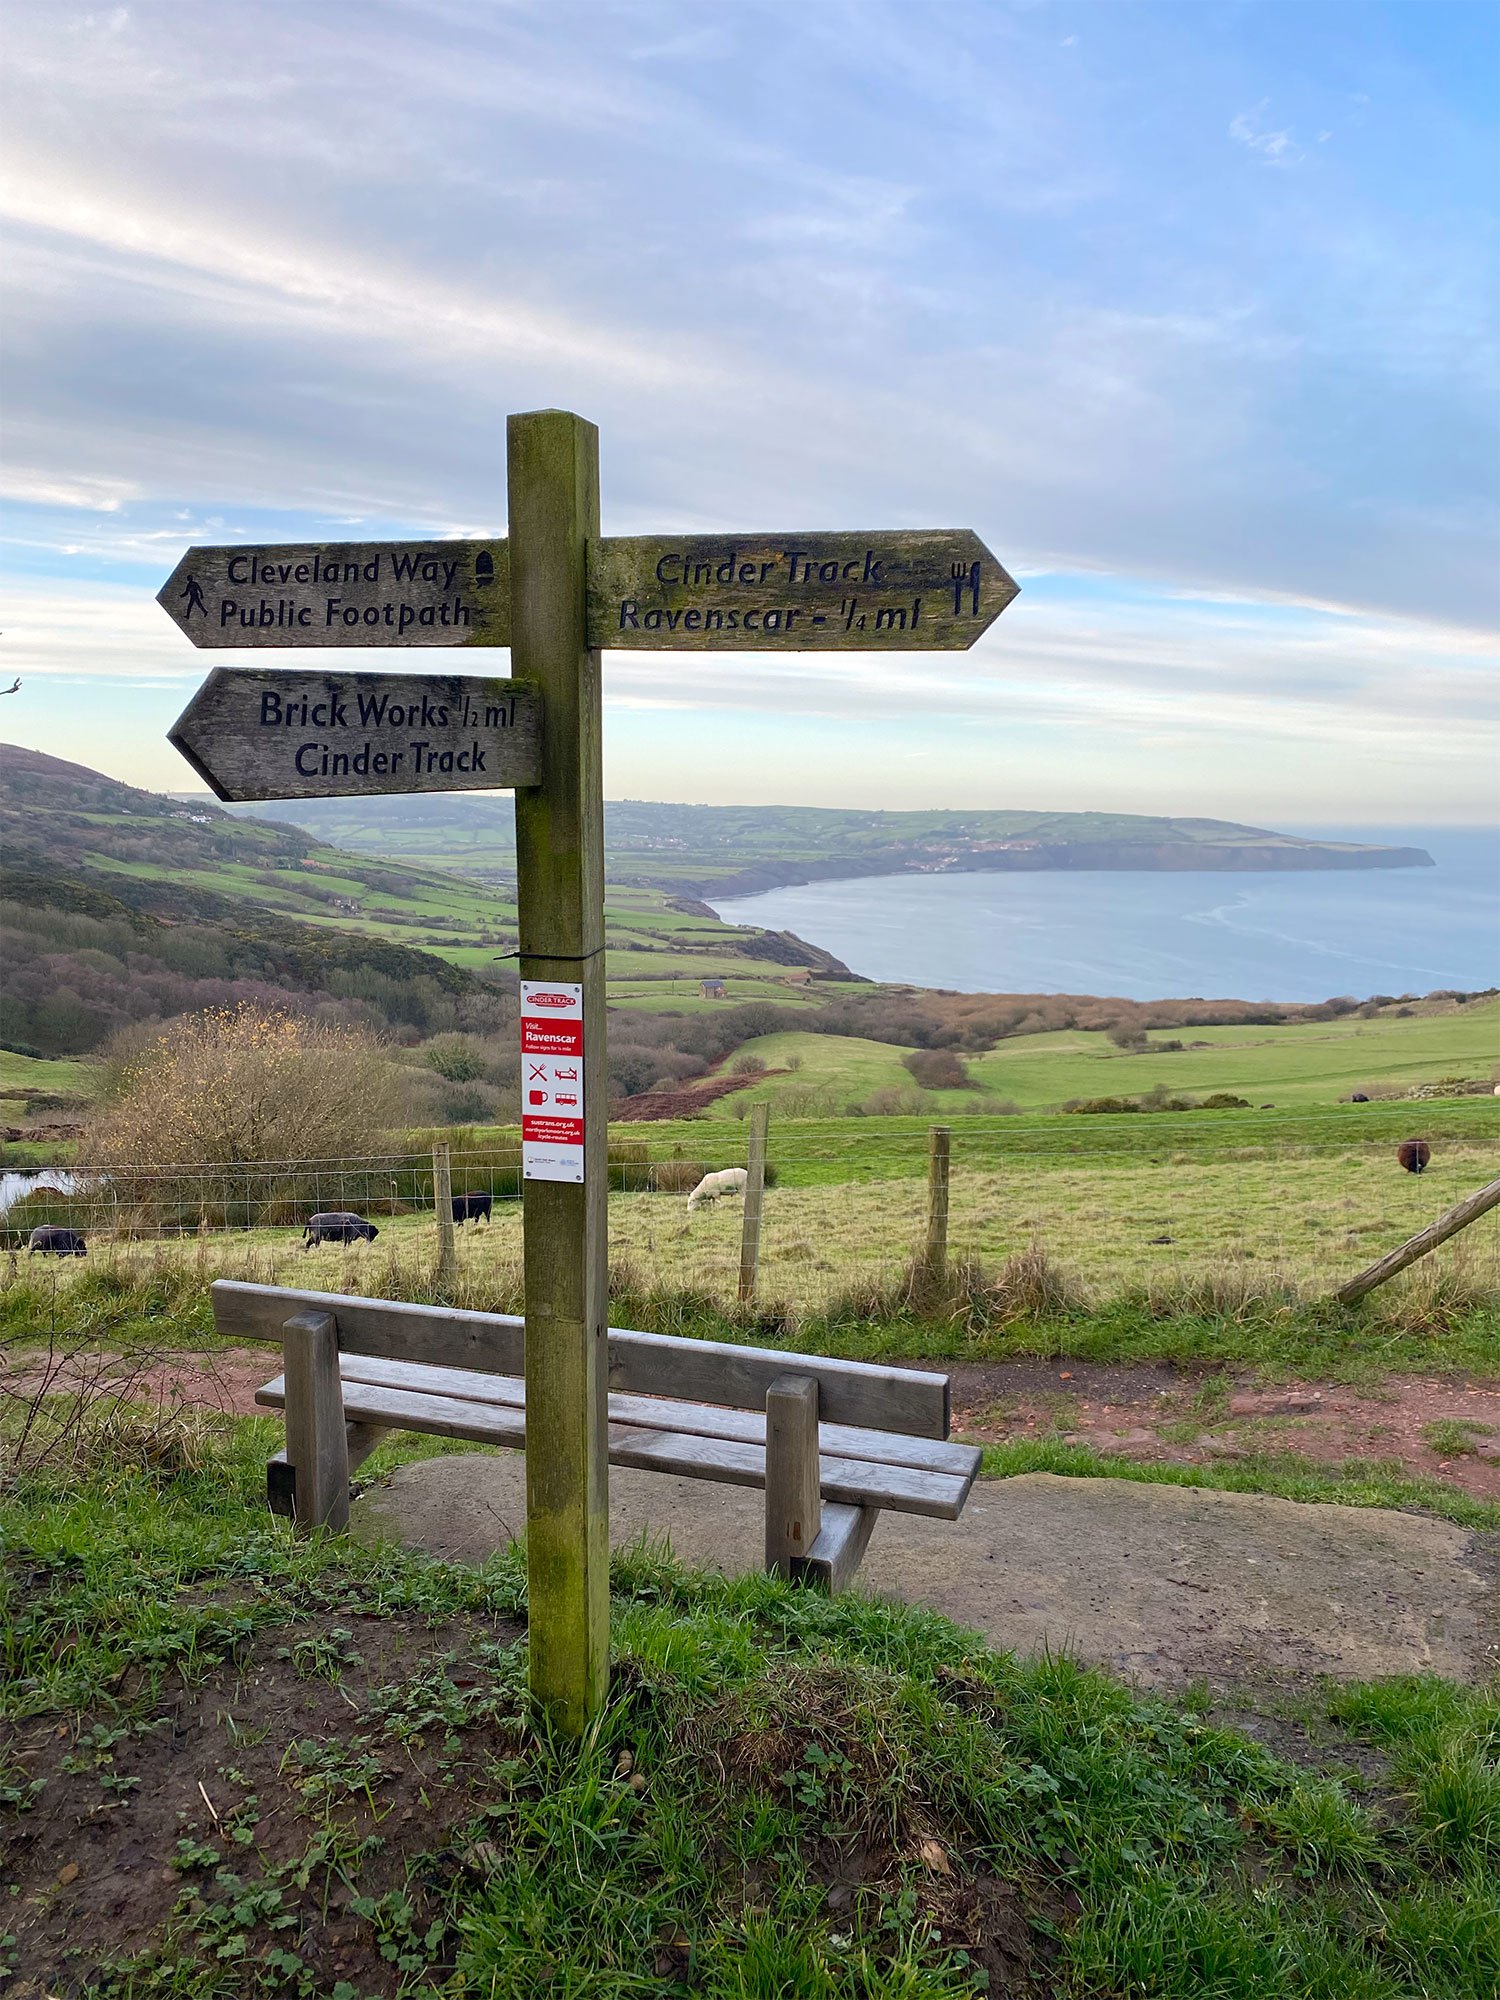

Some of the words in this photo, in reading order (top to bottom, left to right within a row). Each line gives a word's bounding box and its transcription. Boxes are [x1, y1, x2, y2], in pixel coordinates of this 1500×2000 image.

[228, 553, 380, 585] Cleveland
[392, 552, 458, 591] Way
[656, 553, 774, 585] Cinder
[784, 550, 883, 583] Track
[220, 600, 312, 628] Public
[326, 597, 471, 636] Footpath
[619, 600, 801, 631] Ravenscar
[260, 691, 348, 727] Brick
[358, 692, 450, 728] Works
[485, 696, 516, 728] ml
[294, 743, 404, 778] Cinder
[410, 741, 488, 774] Track
[526, 1031, 576, 1043] Ravenscar
[531, 1120, 575, 1128] sustrans.org.uk
